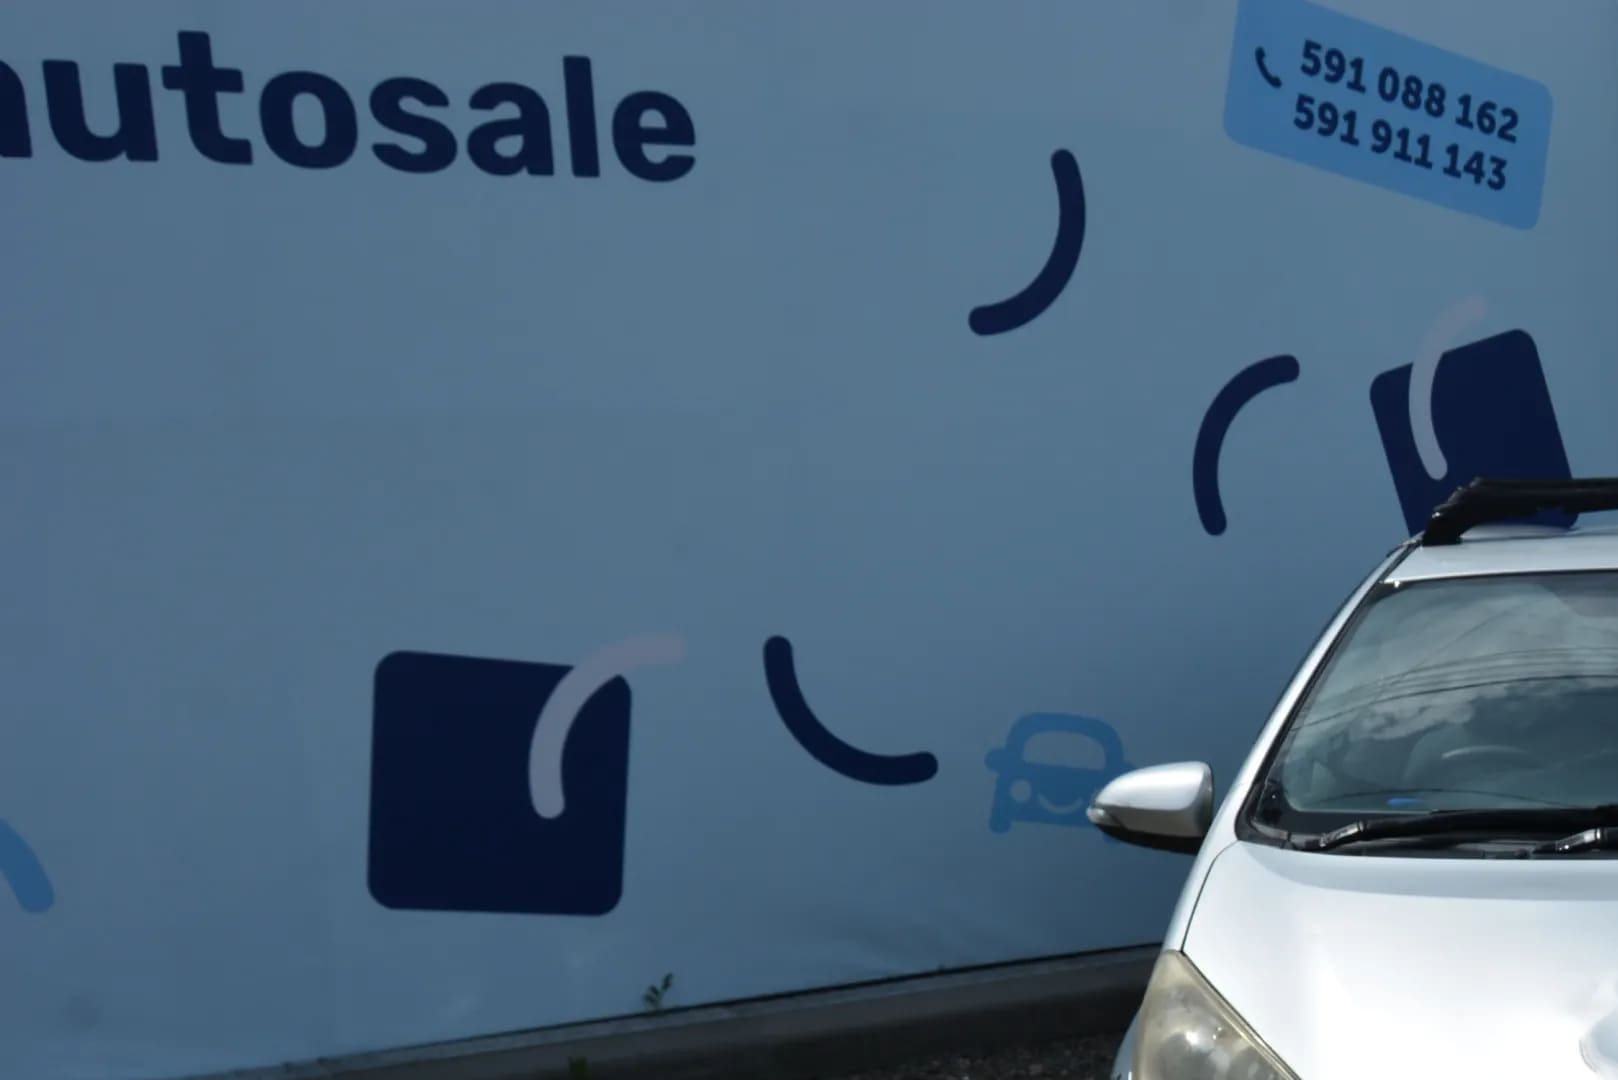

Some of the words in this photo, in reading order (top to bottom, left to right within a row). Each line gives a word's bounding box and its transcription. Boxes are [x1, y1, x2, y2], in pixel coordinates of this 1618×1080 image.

[1293, 93, 1360, 147] 591
[1370, 119, 1433, 170] 911
[1442, 143, 1507, 191] 143
[1300, 39, 1367, 94] 591
[1377, 66, 1446, 119] 088
[1455, 94, 1519, 144] 162
